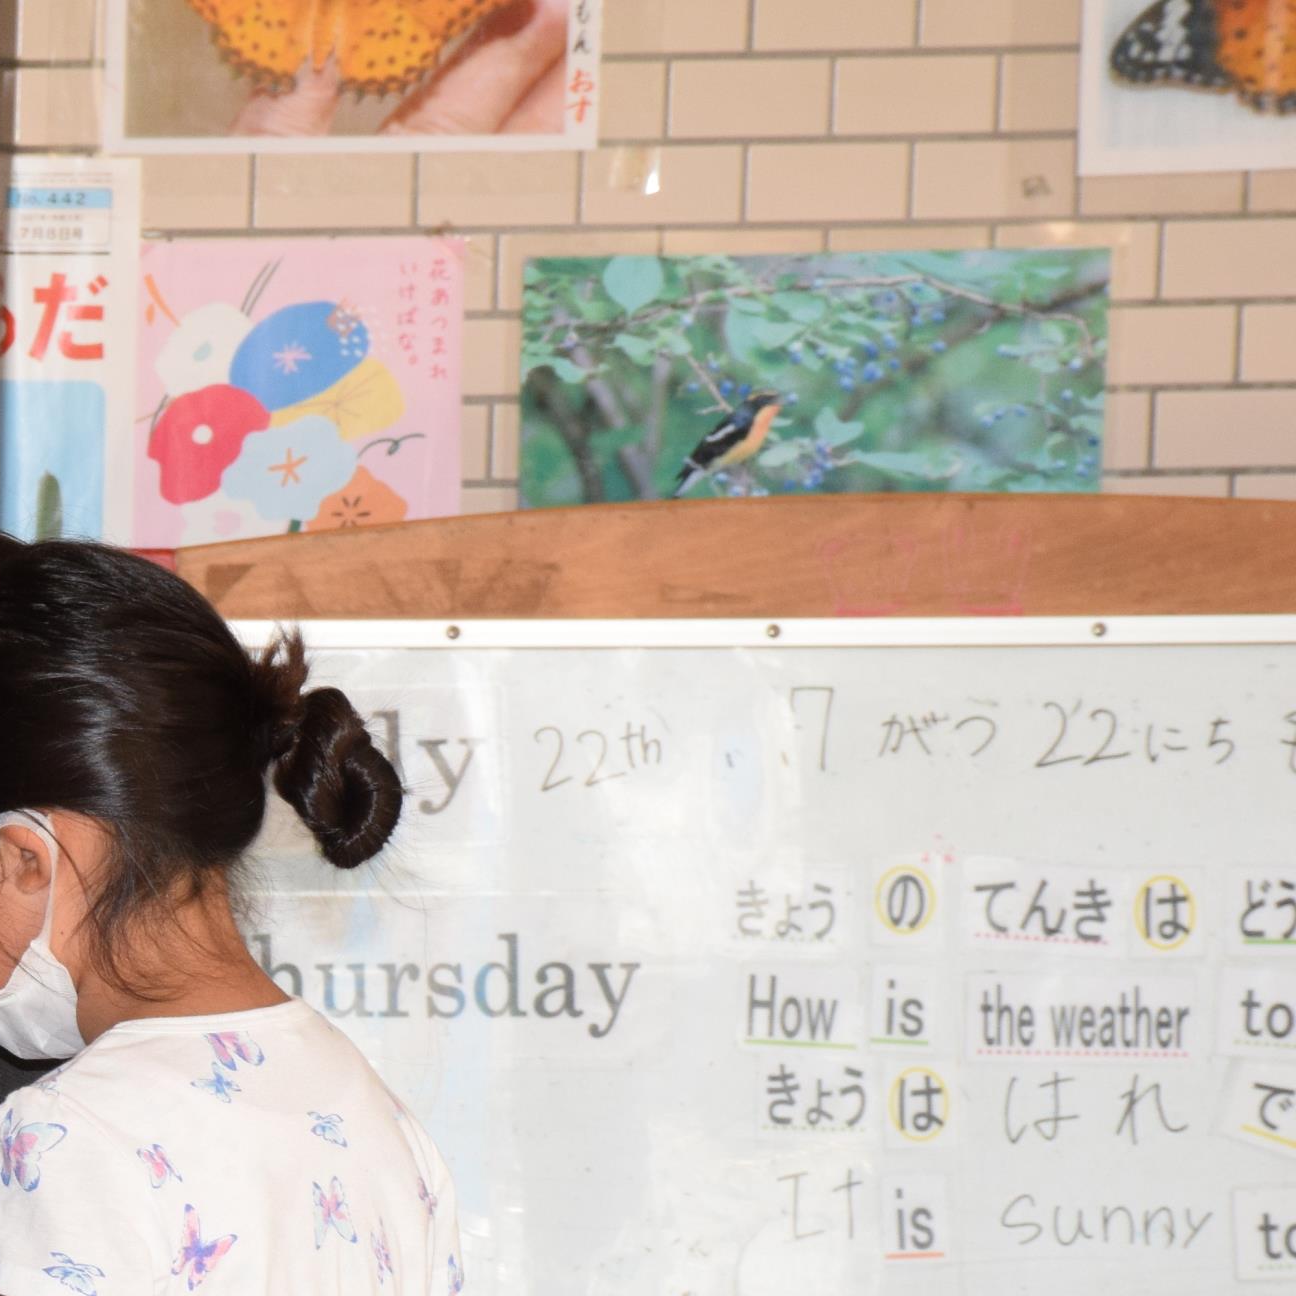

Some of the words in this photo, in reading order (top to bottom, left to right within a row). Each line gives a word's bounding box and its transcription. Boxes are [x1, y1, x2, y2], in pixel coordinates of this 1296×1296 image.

[533, 720, 663, 792] 22th
[736, 879, 836, 940] きょう
[887, 874, 925, 930] の
[973, 878, 1112, 943] てんき
[1144, 883, 1190, 940] は
[254, 932, 642, 1039] hursday
[747, 973, 838, 1041] How
[885, 978, 925, 1037] is
[980, 984, 1035, 1047] the
[1050, 985, 1190, 1049] weather
[1240, 989, 1295, 1039] to
[766, 1063, 866, 1127] きょう
[899, 1075, 944, 1132] は
[896, 1188, 934, 1250] is
